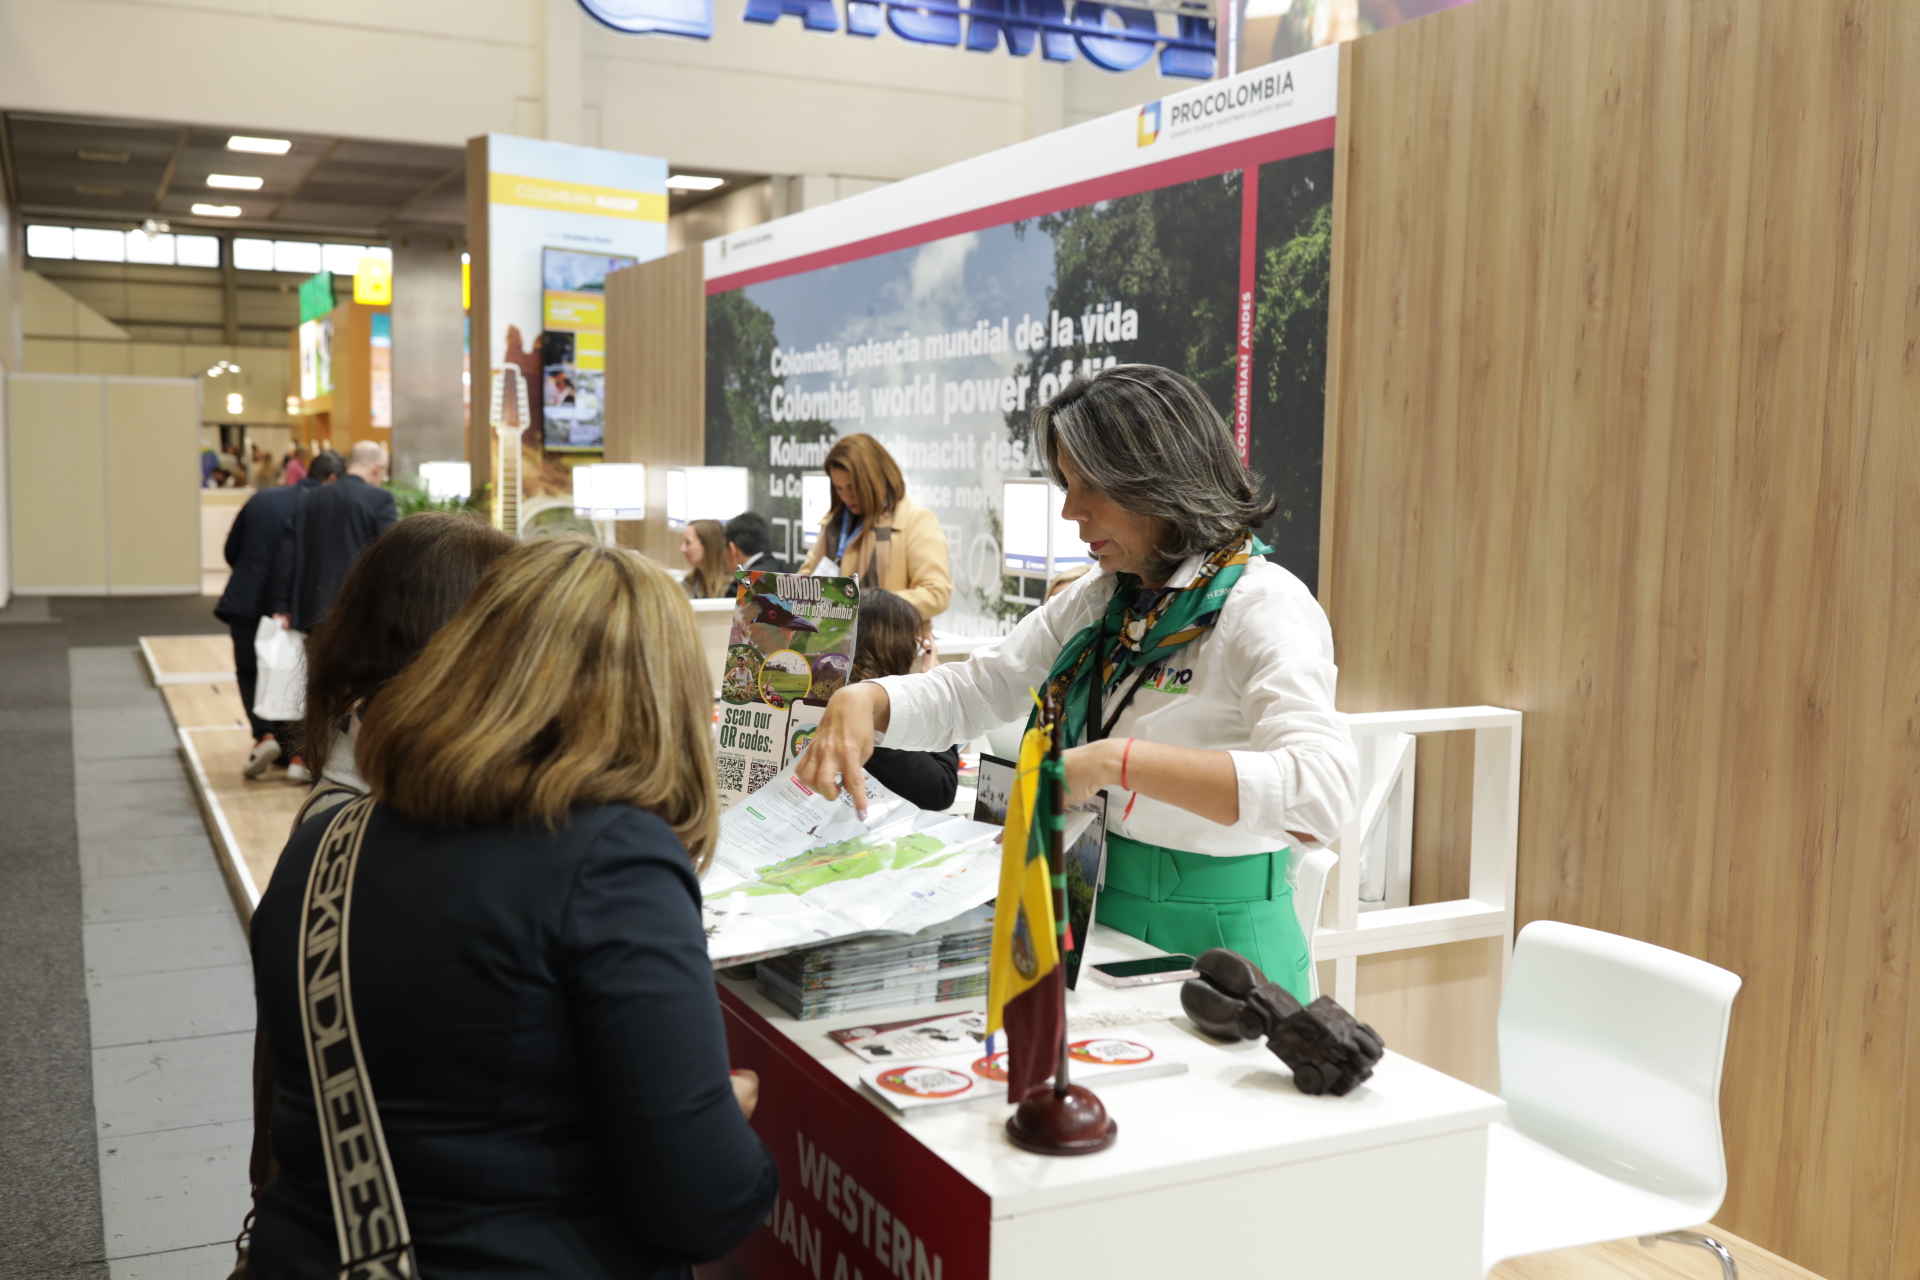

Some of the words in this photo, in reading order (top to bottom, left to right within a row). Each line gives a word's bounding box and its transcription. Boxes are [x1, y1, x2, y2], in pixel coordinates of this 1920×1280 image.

[1171, 71, 1294, 127] PROCOLOMBIA
[770, 342, 843, 378] Colombia,
[846, 330, 919, 376] potencia
[925, 316, 1009, 361] mundial
[1015, 312, 1045, 352] de
[1051, 308, 1074, 348] la
[1081, 302, 1139, 344] vida
[1241, 291, 1252, 349] ANDES
[770, 380, 865, 426] Colombia,
[871, 373, 936, 418] world
[943, 375, 1031, 424] power
[1038, 358, 1074, 407] of
[981, 431, 1026, 471] des
[769, 473, 784, 497] La
[811, 604, 821, 619] of
[720, 724, 738, 749] QR
[738, 729, 774, 754] codes:
[725, 707, 752, 728] scan
[753, 711, 772, 730] our
[797, 1129, 943, 1280] WESTERN
